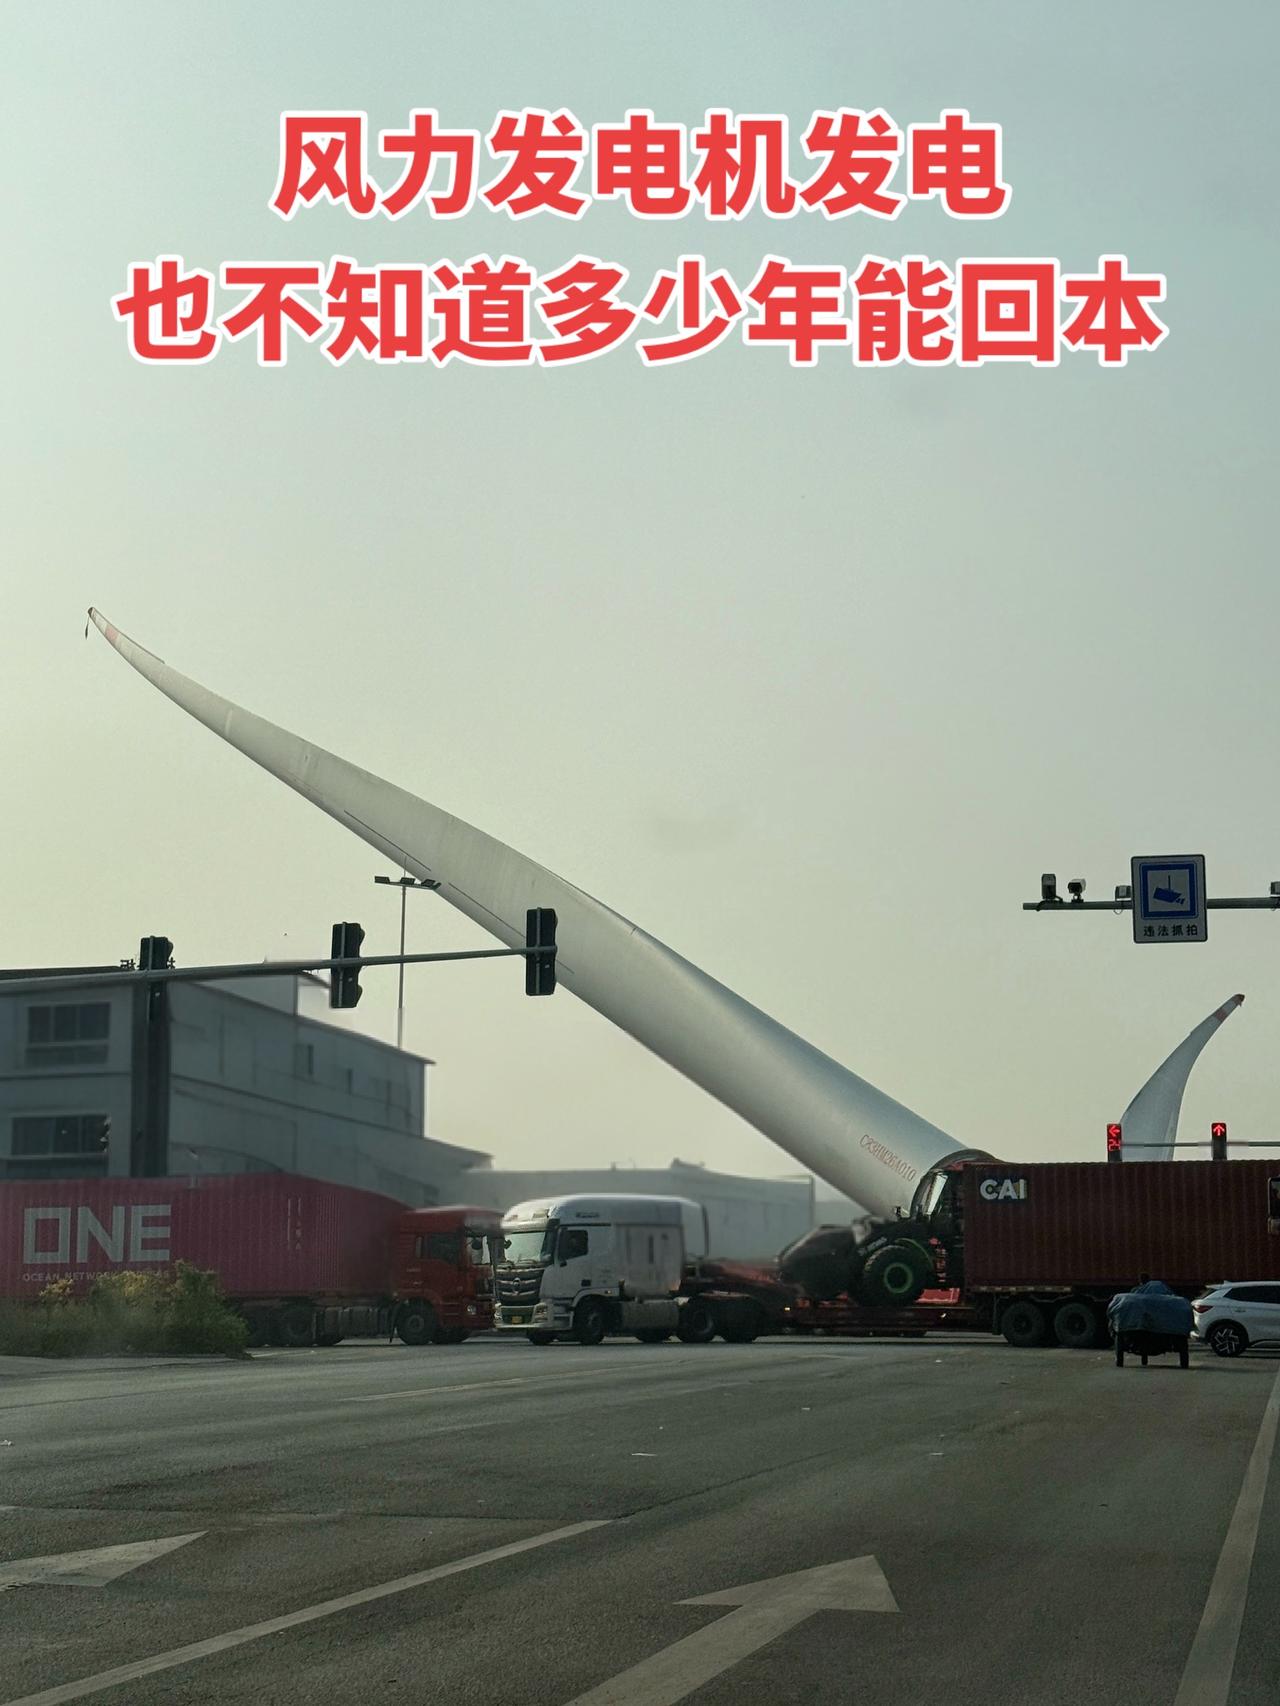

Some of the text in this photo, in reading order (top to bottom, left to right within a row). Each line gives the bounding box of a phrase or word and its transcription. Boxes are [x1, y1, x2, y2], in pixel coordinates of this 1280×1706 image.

[1143, 923, 1198, 938] 违法抓拍
[979, 1178, 1026, 1200] CAI
[23, 1204, 172, 1264] ONE
[22, 1271, 60, 1282] OCEAN
